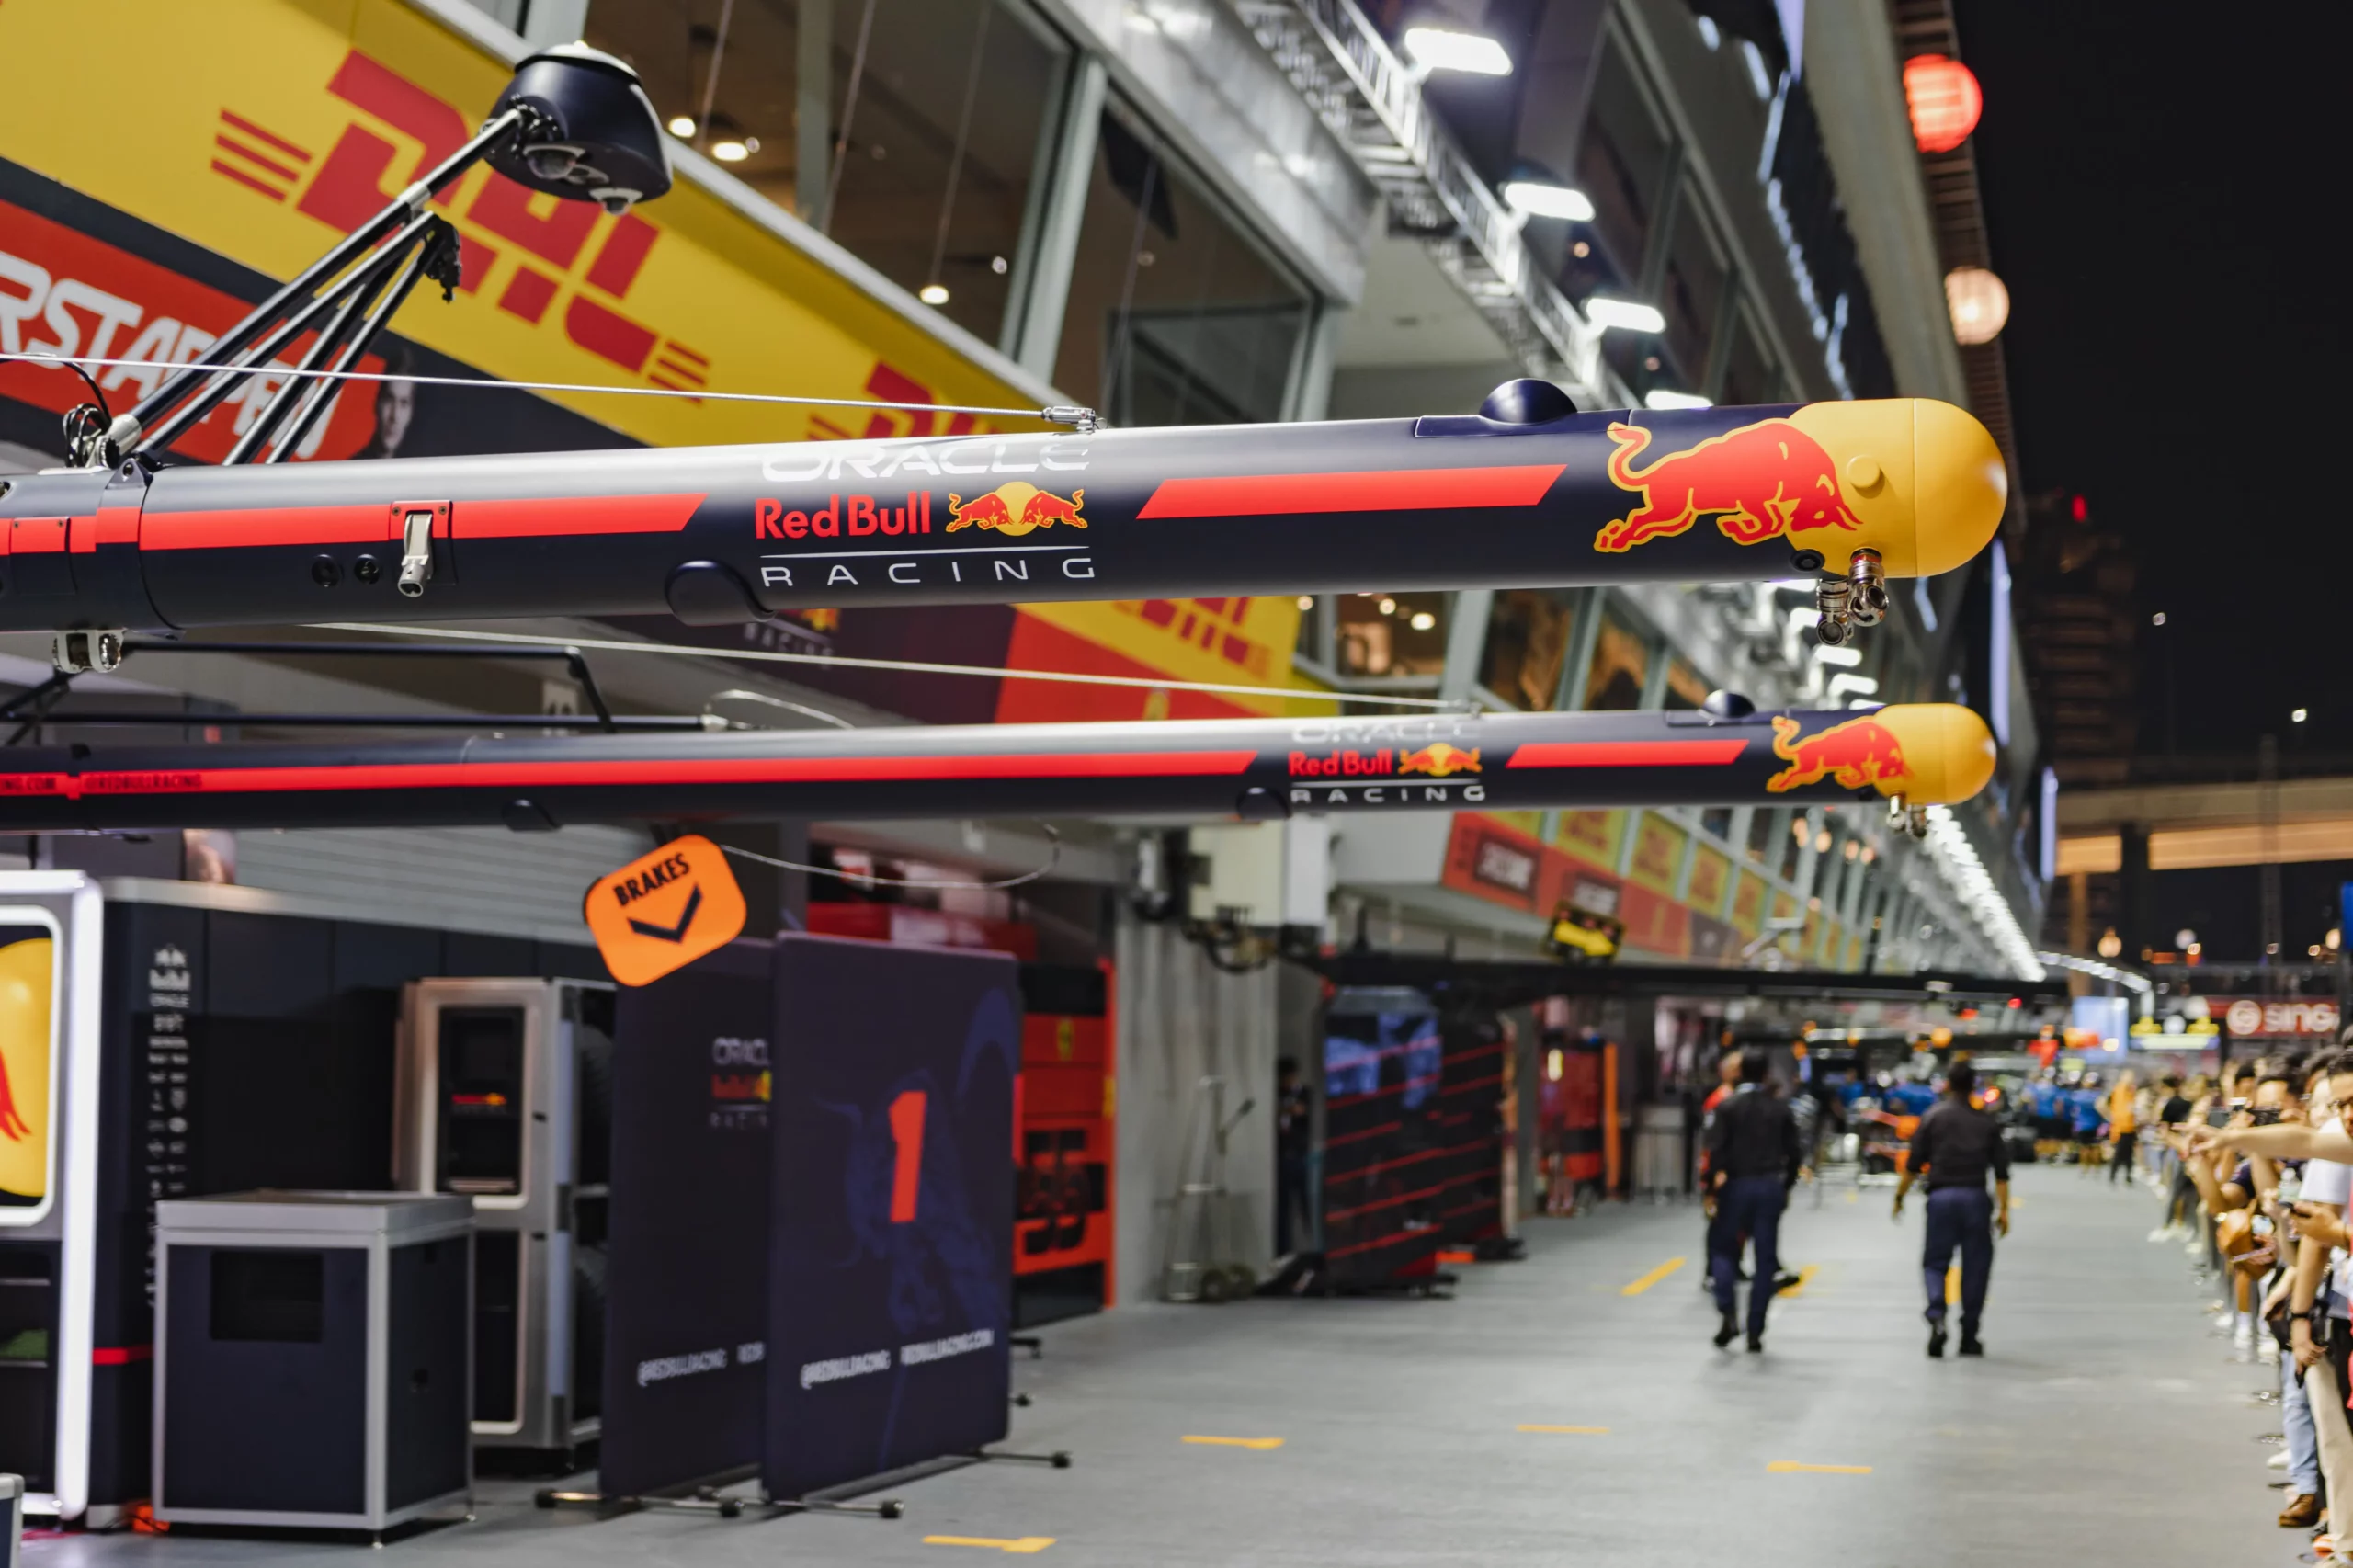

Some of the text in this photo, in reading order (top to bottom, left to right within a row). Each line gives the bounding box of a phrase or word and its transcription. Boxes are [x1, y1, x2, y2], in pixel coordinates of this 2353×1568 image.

[760, 443, 1091, 483] ORACLE
[760, 557, 1096, 587] RACING
[1290, 785, 1486, 804] RACING
[613, 853, 690, 907] BRAKES
[889, 1091, 927, 1223] 1
